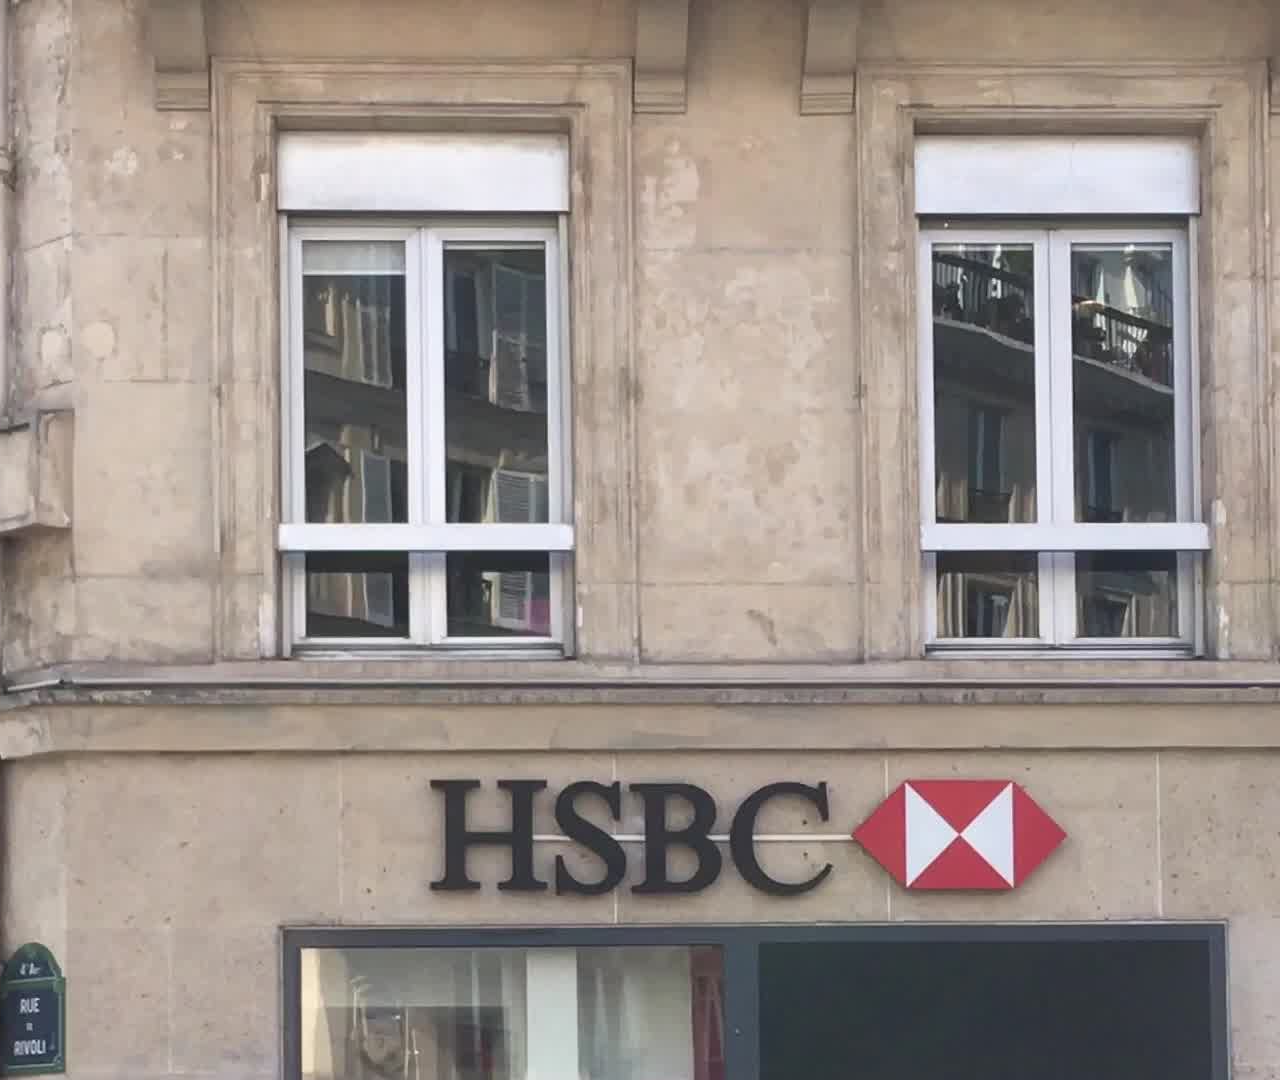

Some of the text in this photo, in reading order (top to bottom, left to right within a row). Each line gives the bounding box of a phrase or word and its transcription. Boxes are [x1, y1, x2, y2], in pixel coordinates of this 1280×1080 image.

[429, 779, 833, 897] HSBC
[20, 998, 40, 1013] RUE
[14, 1039, 46, 1056] RIVOLI
